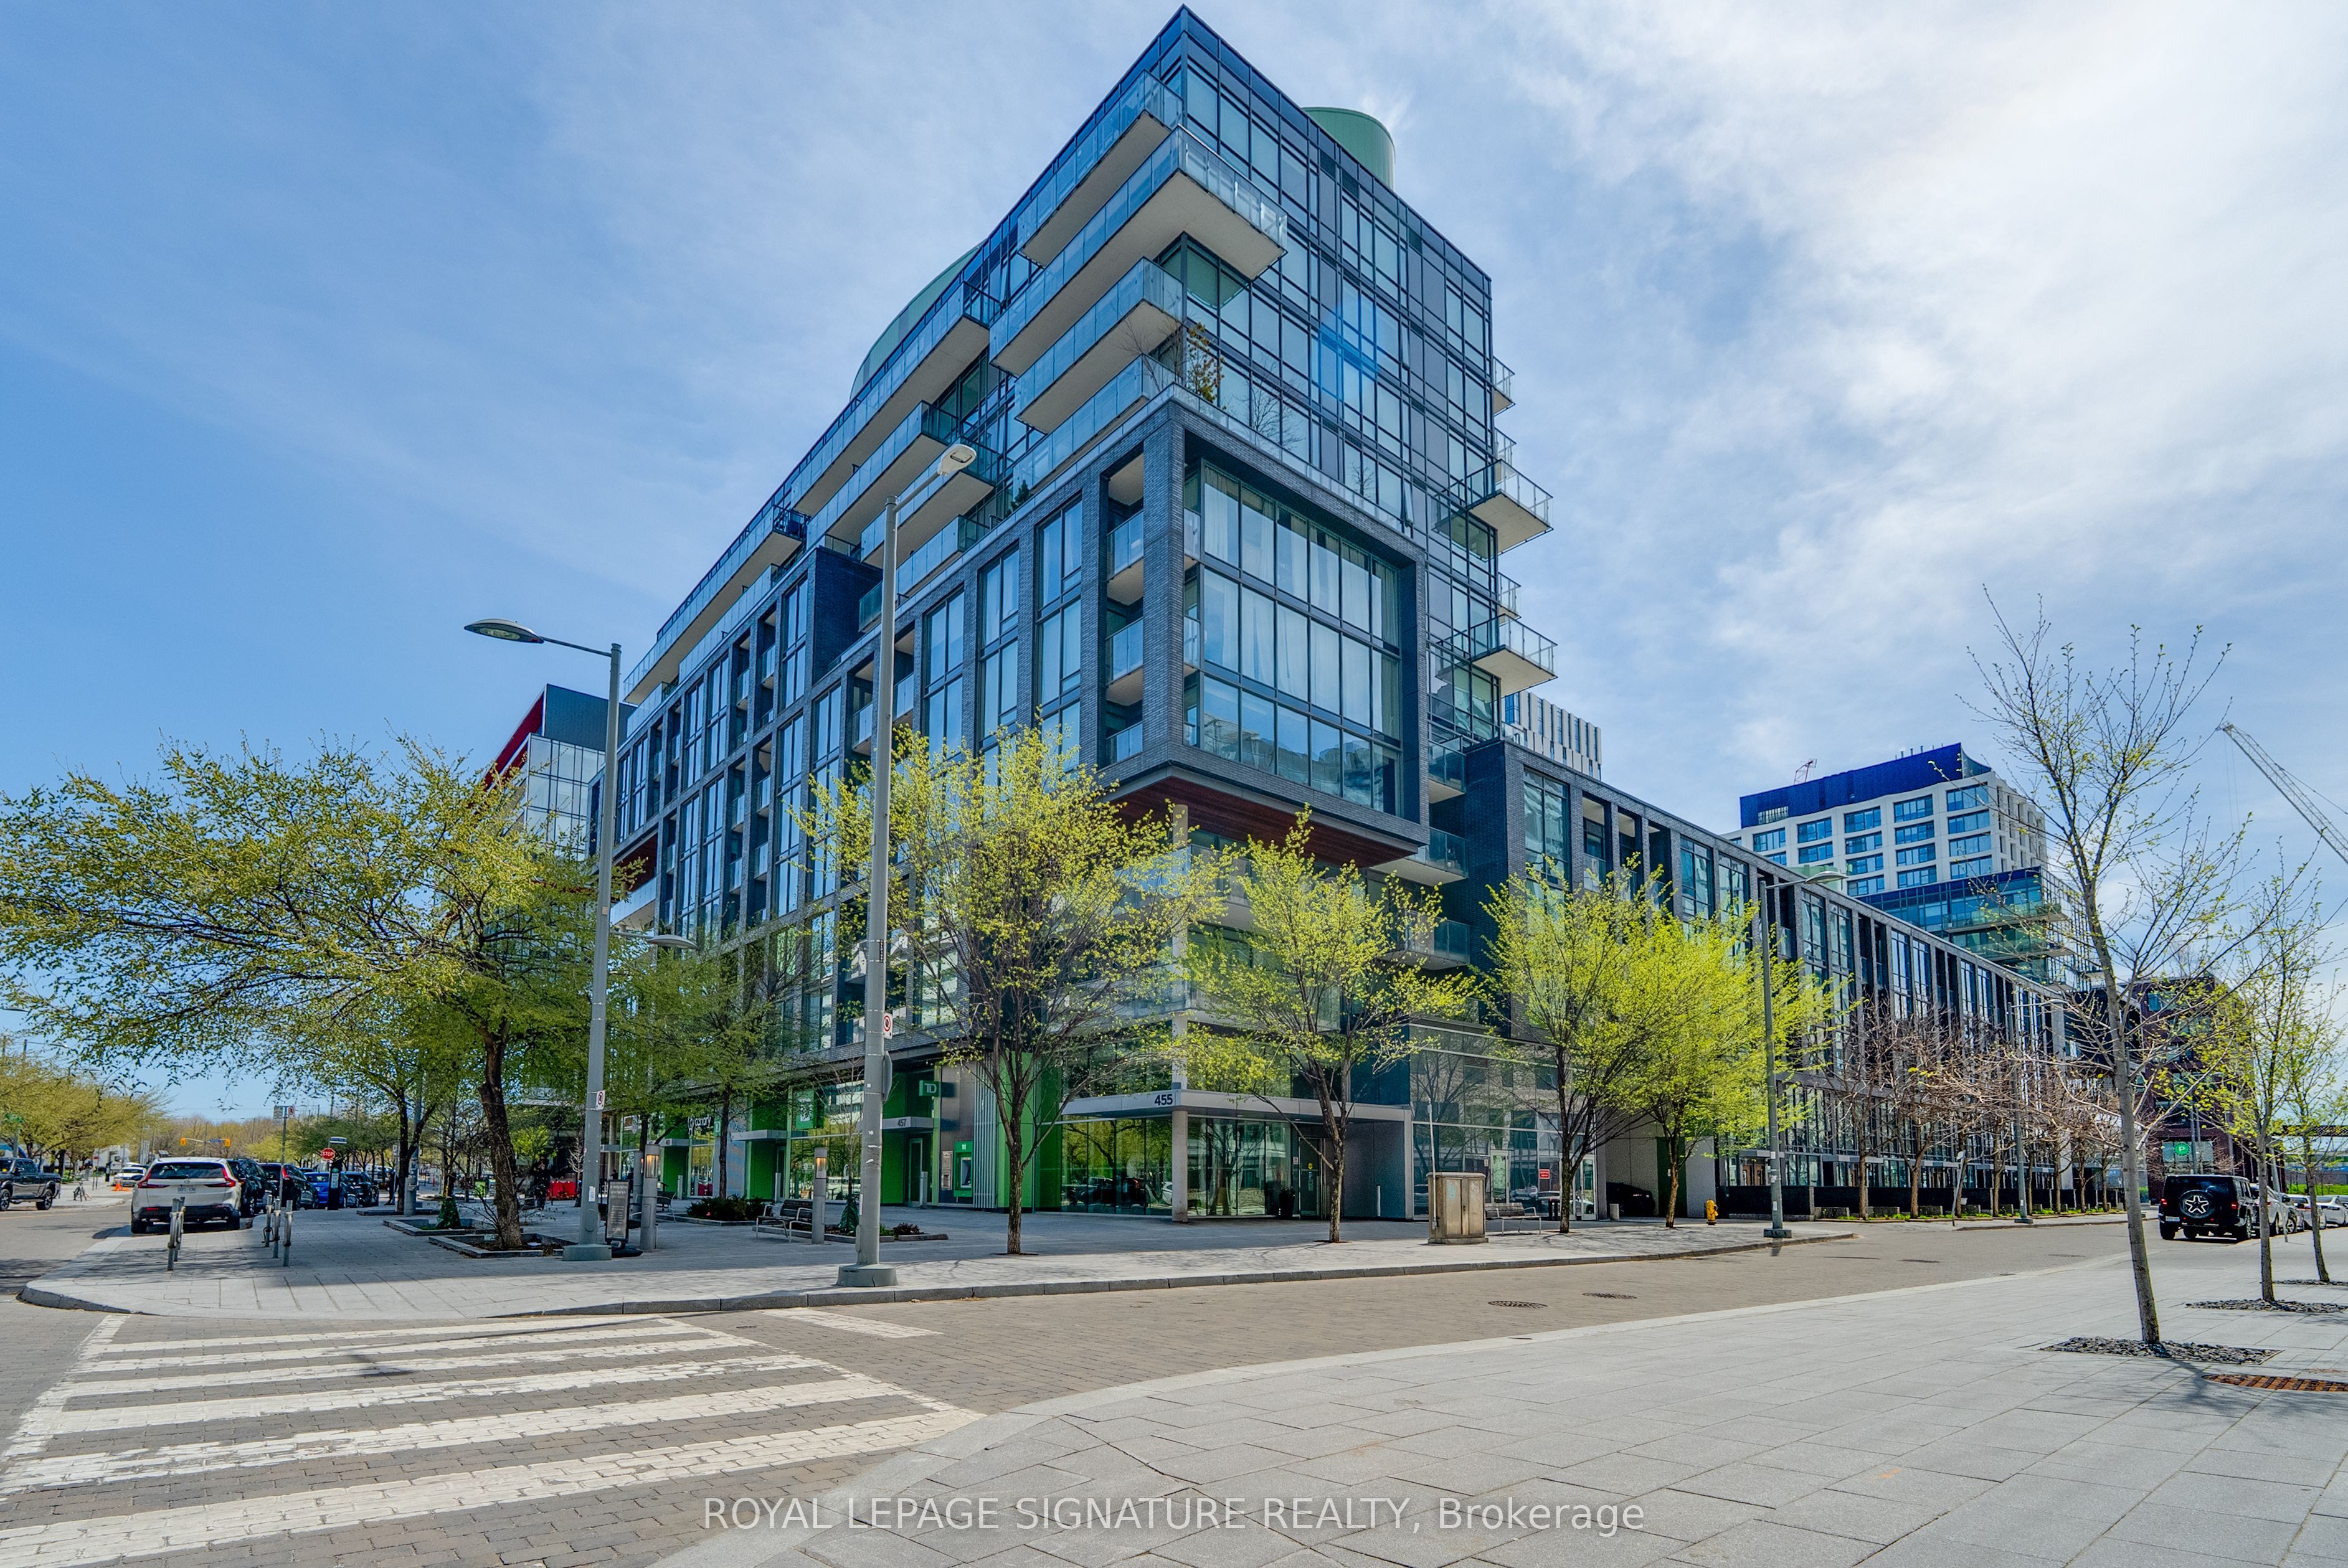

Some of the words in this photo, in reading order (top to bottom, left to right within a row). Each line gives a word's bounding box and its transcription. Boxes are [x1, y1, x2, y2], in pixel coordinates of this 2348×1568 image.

[924, 1084, 937, 1093] TD
[1155, 1093, 1173, 1105] 455
[897, 1118, 907, 1126] 457
